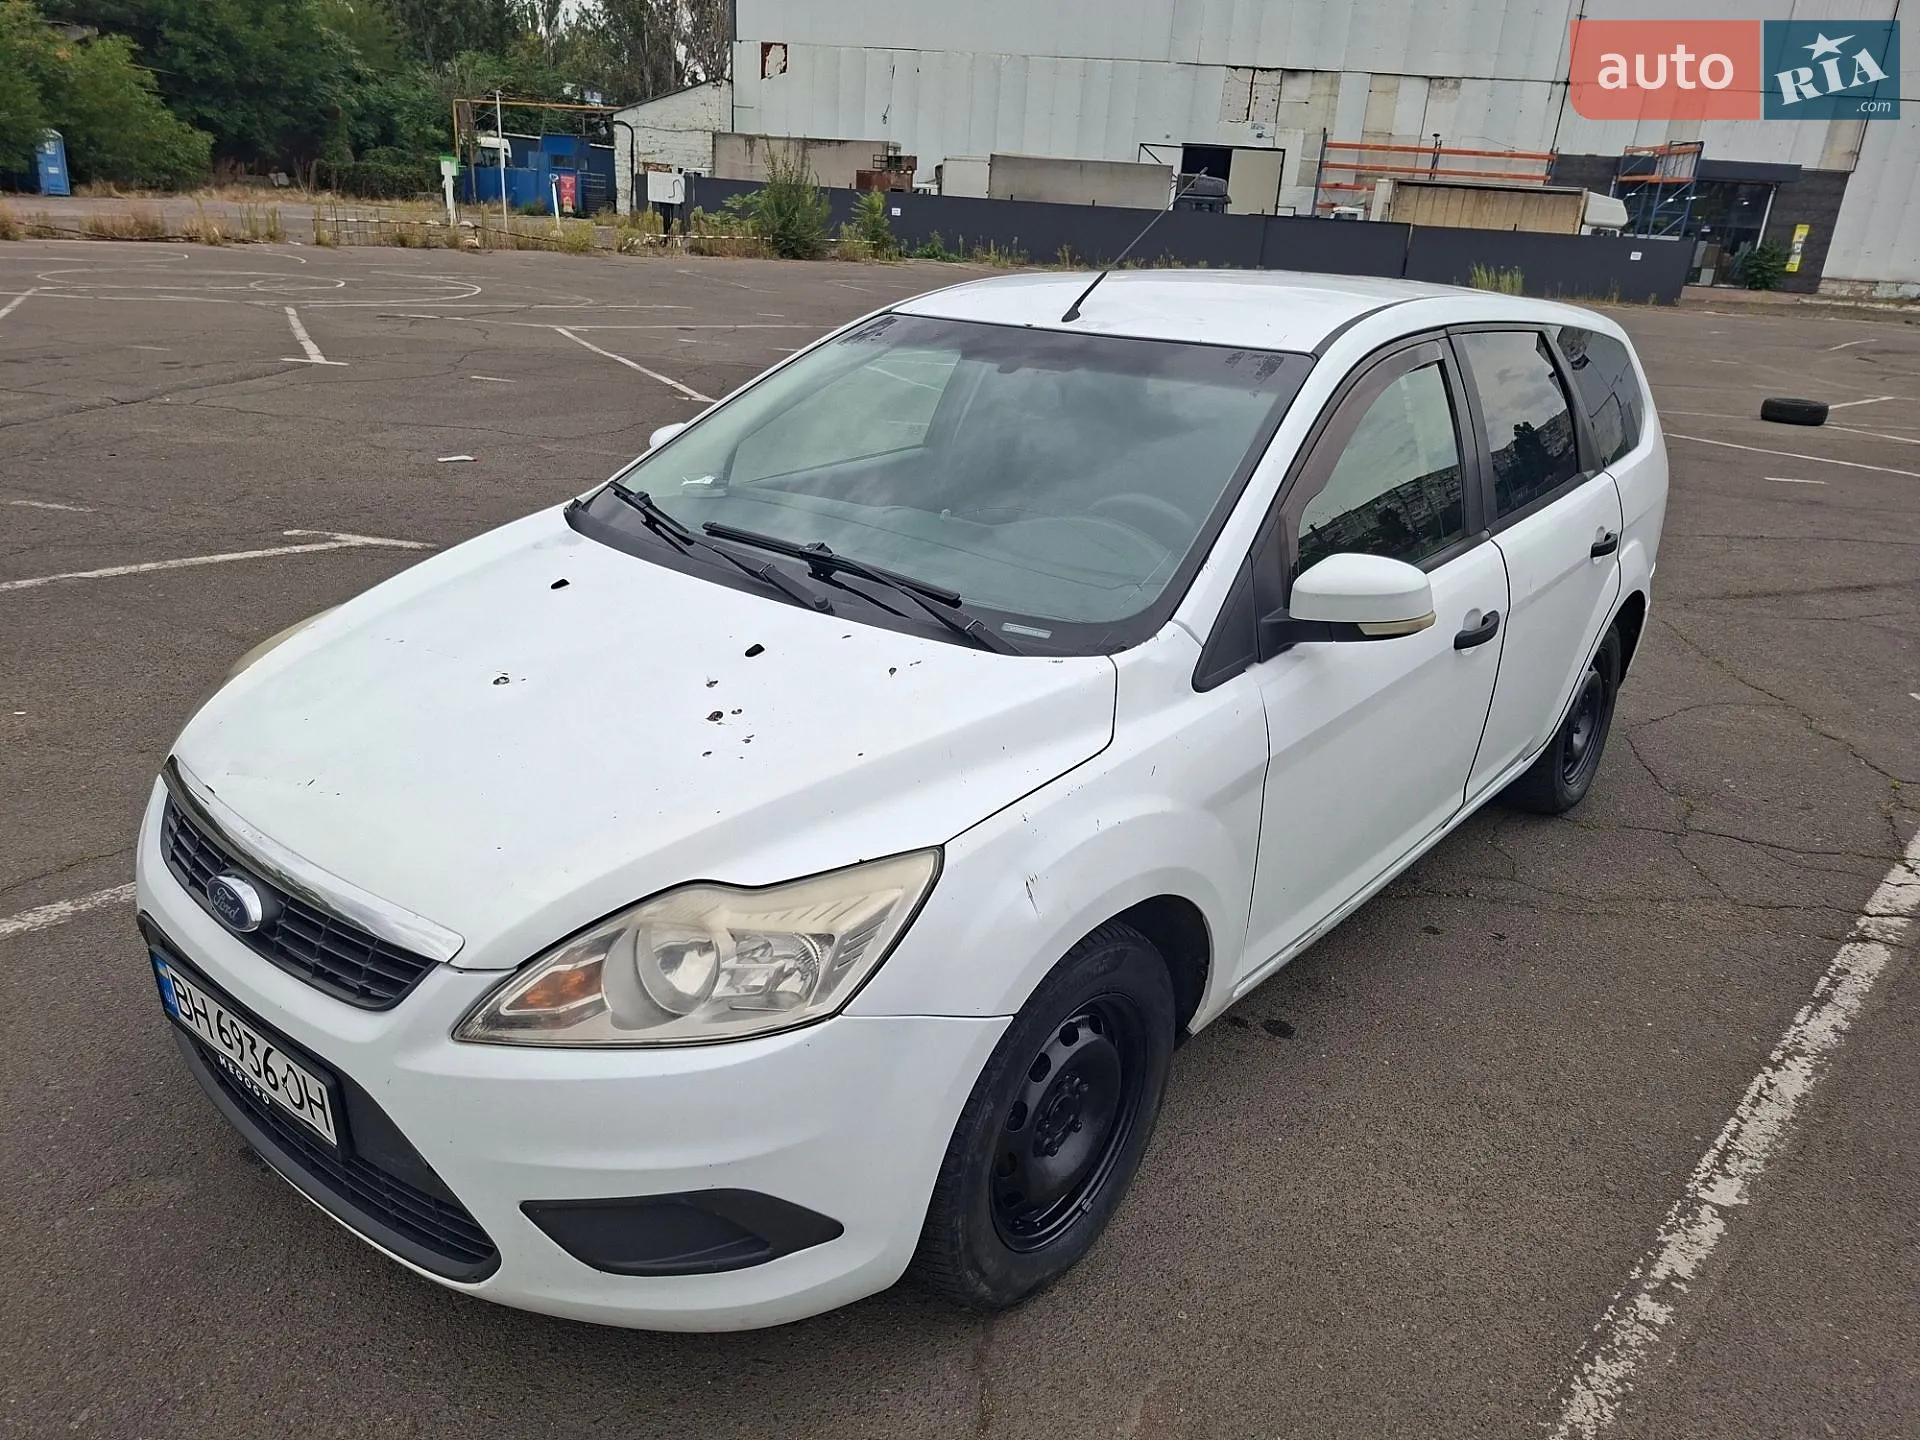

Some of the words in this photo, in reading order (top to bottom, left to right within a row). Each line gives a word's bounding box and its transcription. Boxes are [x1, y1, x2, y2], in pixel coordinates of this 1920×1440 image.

[213, 886, 240, 921] Ford
[169, 972, 214, 1040] BH
[216, 1009, 279, 1092] 6936
[281, 1063, 332, 1133] OH
[218, 1054, 270, 1105] MEGOGO
